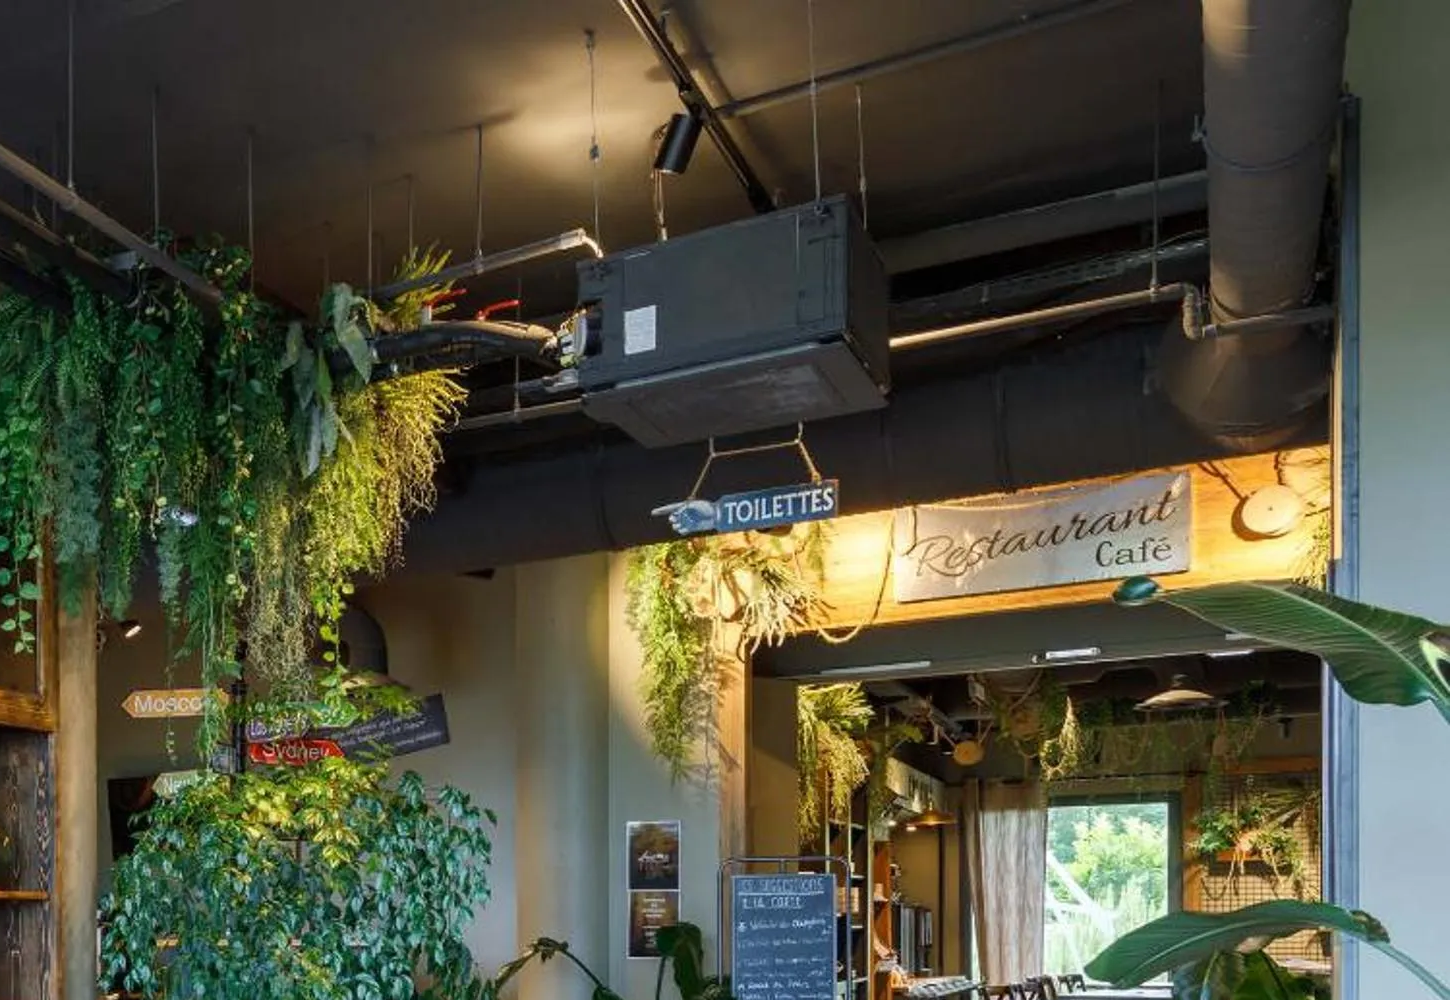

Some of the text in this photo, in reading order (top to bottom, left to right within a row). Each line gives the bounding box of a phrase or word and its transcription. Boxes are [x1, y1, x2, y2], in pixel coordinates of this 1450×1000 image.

[724, 487, 834, 524] TOILETTES
[916, 490, 1179, 577] Restaurant
[1095, 537, 1172, 568] Café
[133, 695, 206, 713] Mosco
